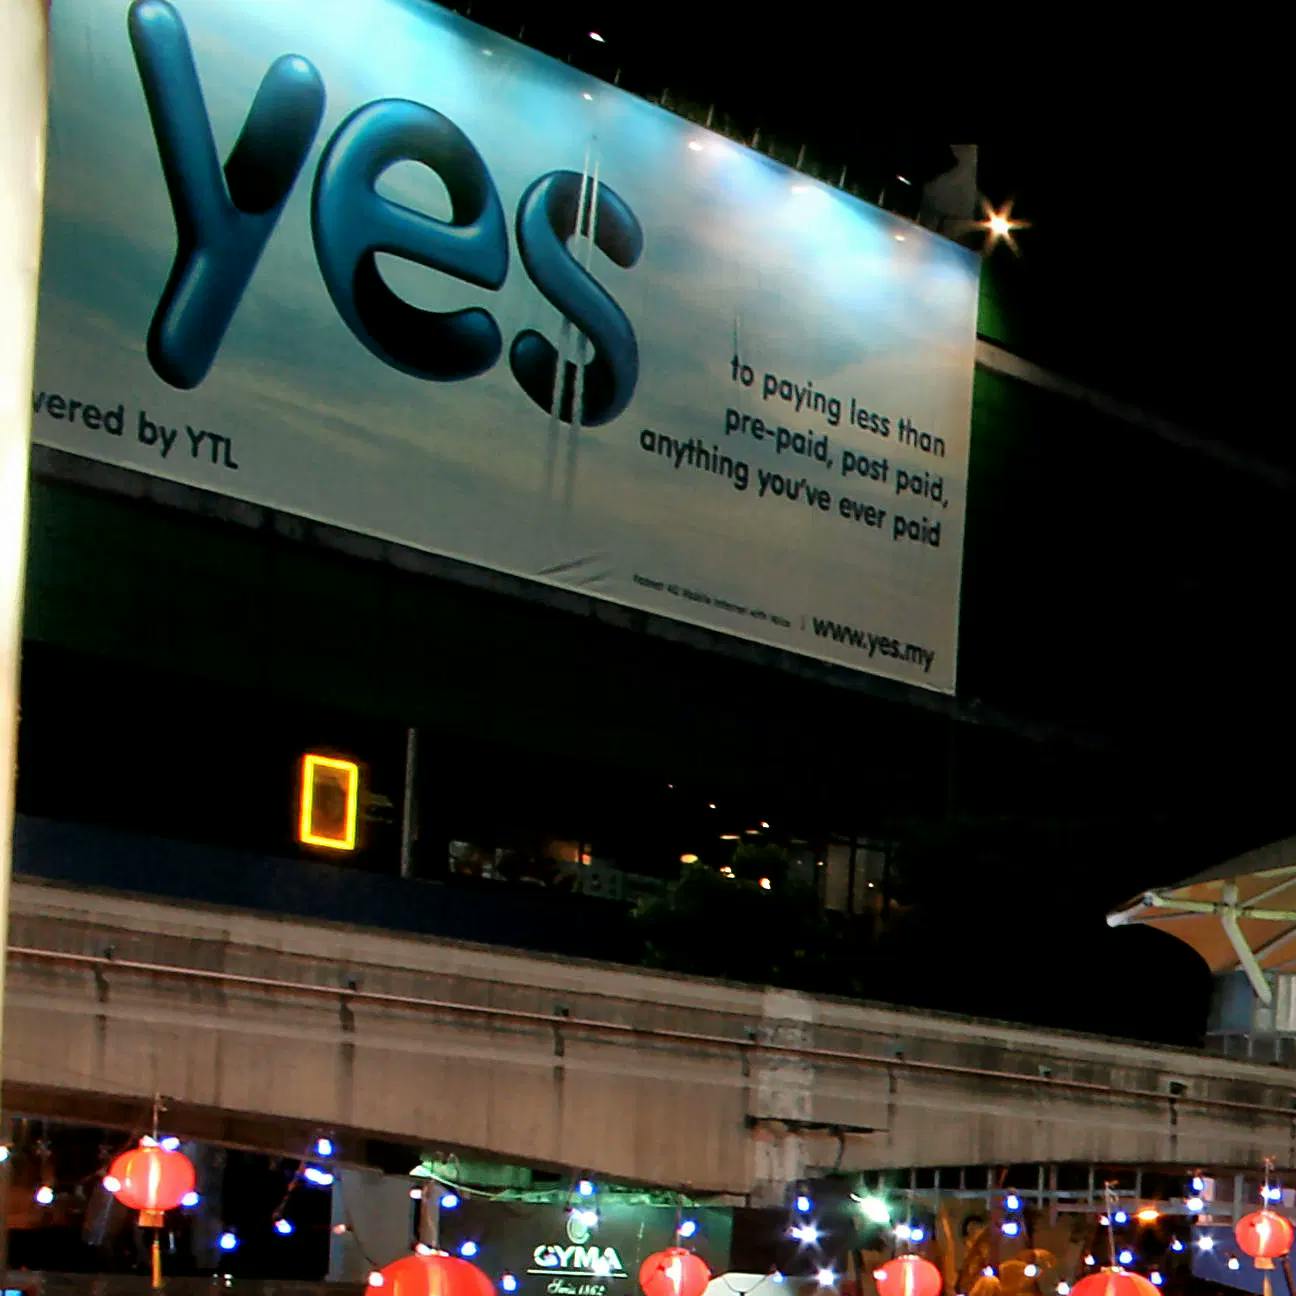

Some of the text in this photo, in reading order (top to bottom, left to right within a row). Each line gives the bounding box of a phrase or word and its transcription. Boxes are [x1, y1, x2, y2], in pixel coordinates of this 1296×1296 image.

[138, 410, 177, 459] by
[187, 425, 239, 470] YTL
[731, 354, 946, 458] to paying less than
[640, 427, 941, 547] anything you've ever paid
[725, 407, 949, 509] pre-paid, post paid,
[812, 616, 936, 673] www.yes.my
[533, 1245, 623, 1270] CYMA
